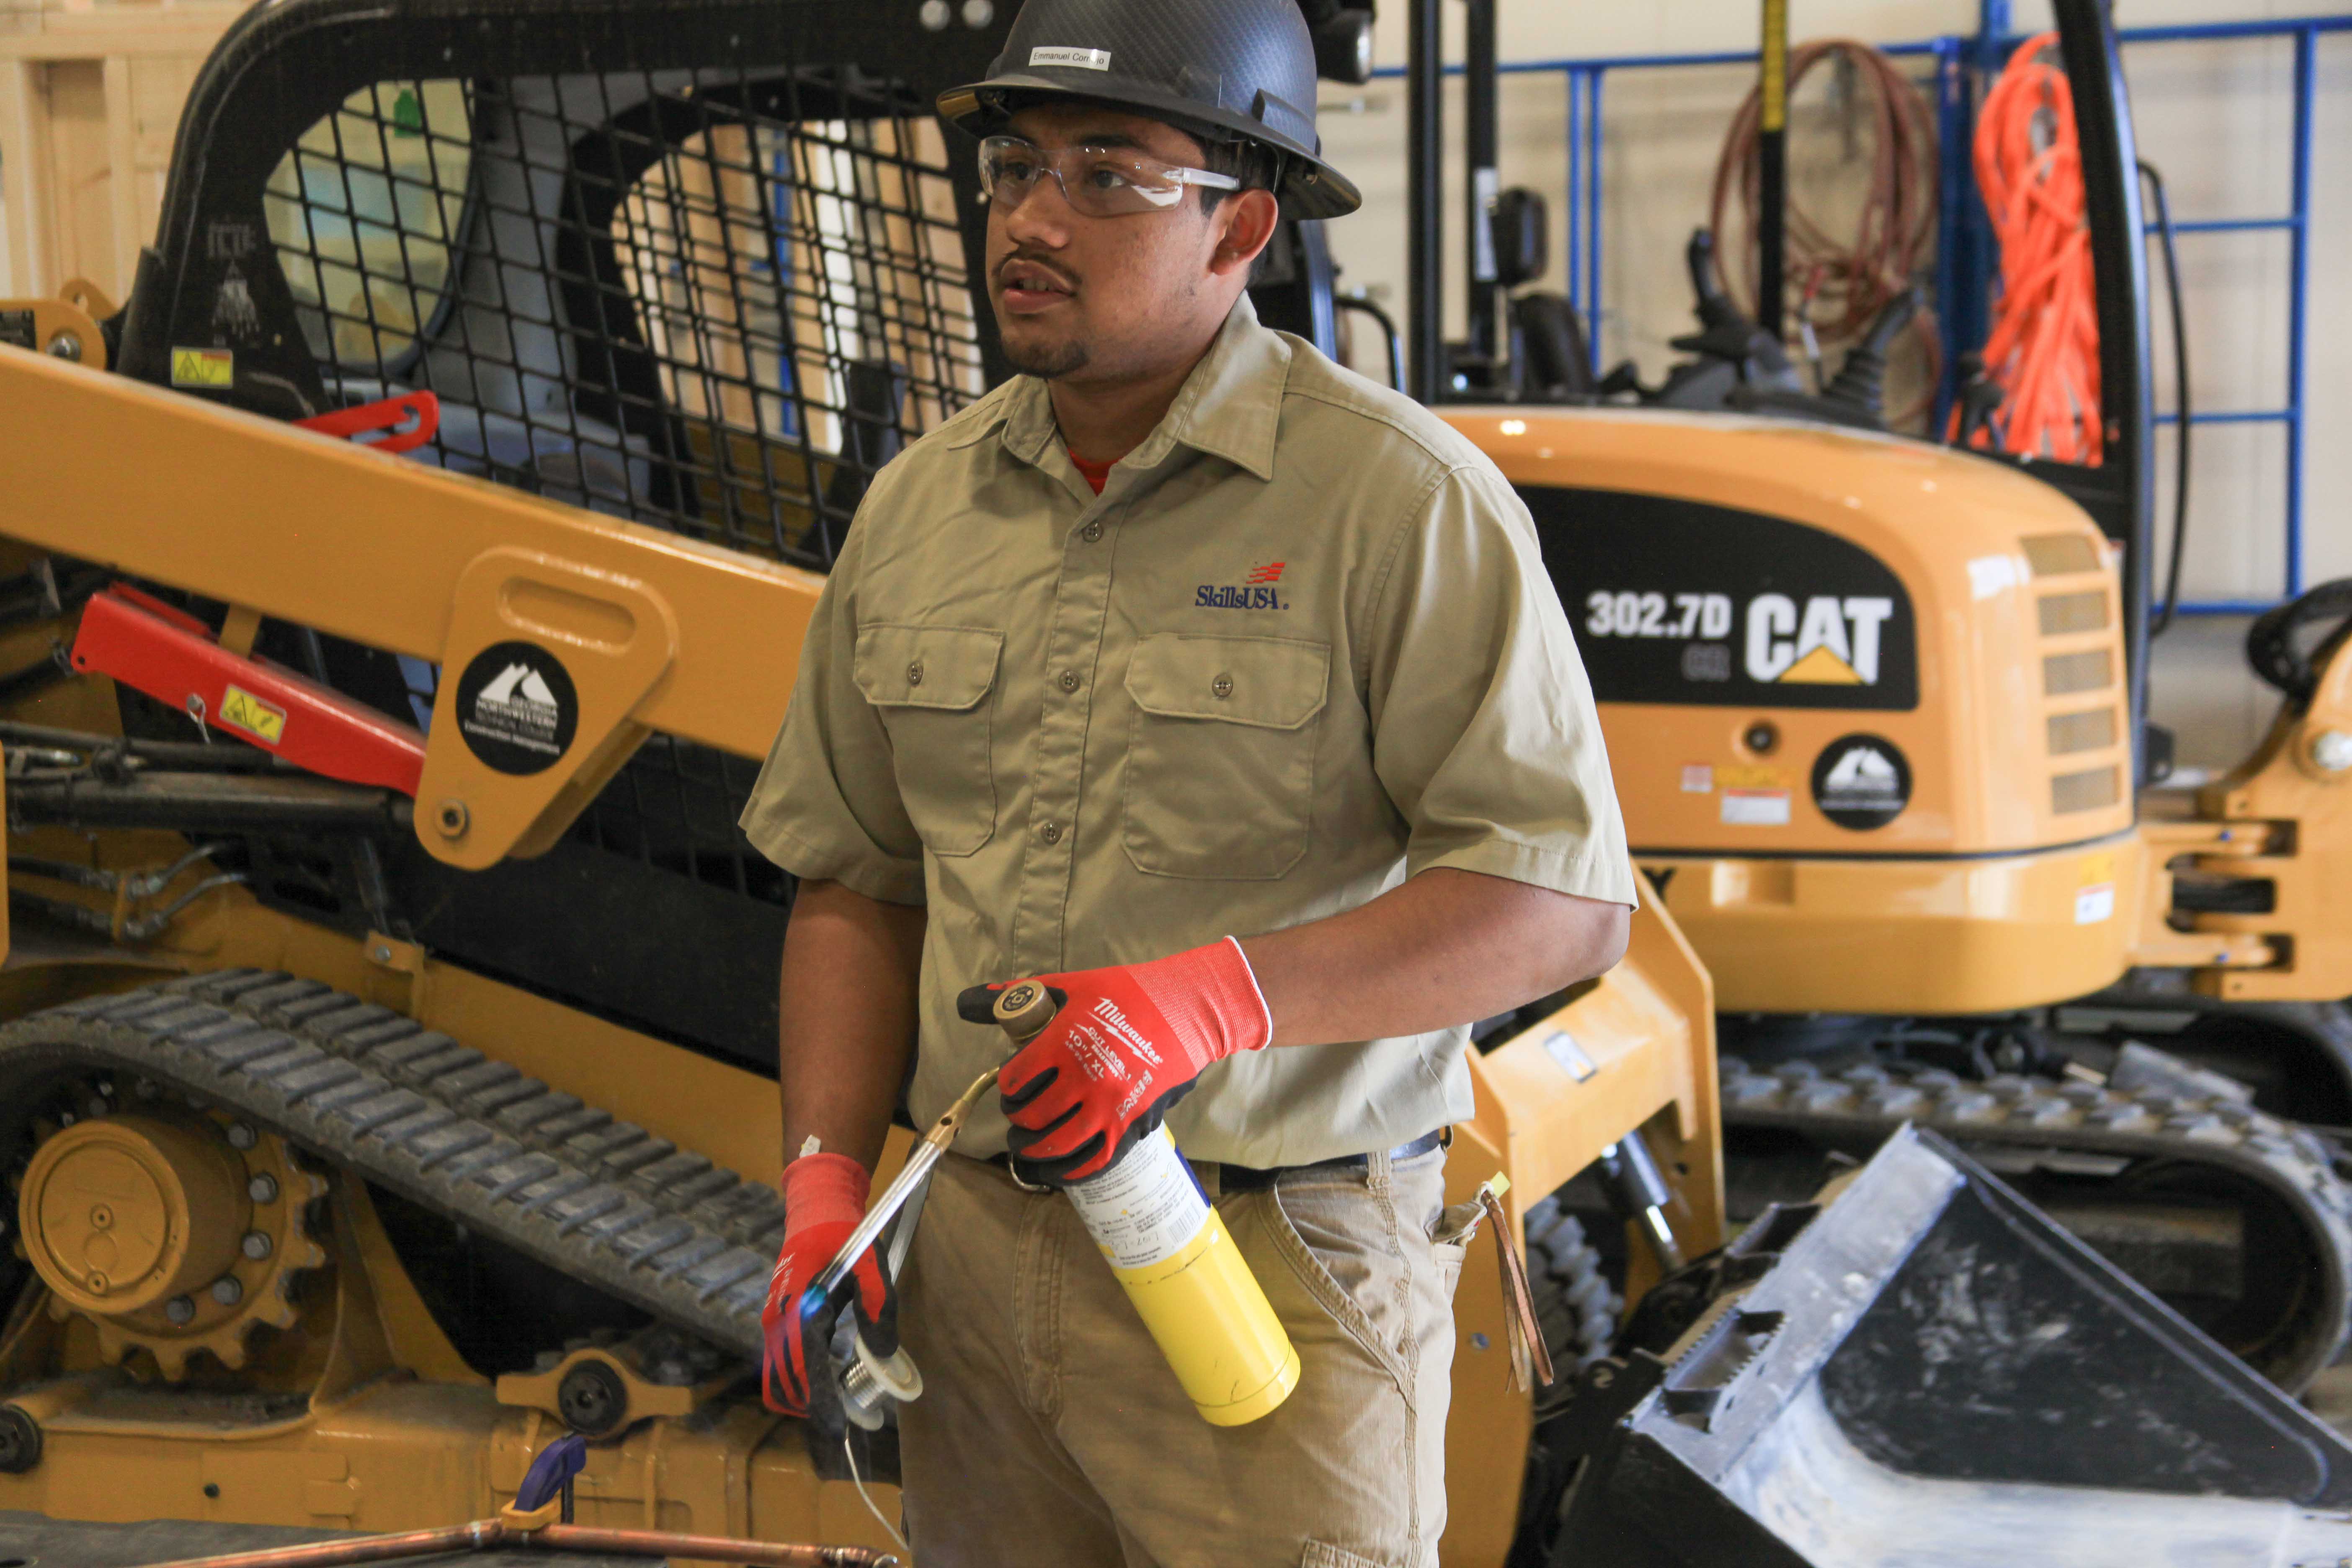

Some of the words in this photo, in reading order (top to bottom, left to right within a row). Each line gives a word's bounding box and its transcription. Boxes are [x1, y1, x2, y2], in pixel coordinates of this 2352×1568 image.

[1033, 52, 1070, 61] Emmanuel
[1195, 585, 1279, 609] SkillsUSA
[1585, 591, 1733, 640] 302.7D
[1744, 593, 1893, 686] CAT
[1093, 996, 1162, 1065] Milwaukee
[1091, 1059, 1104, 1079] XL
